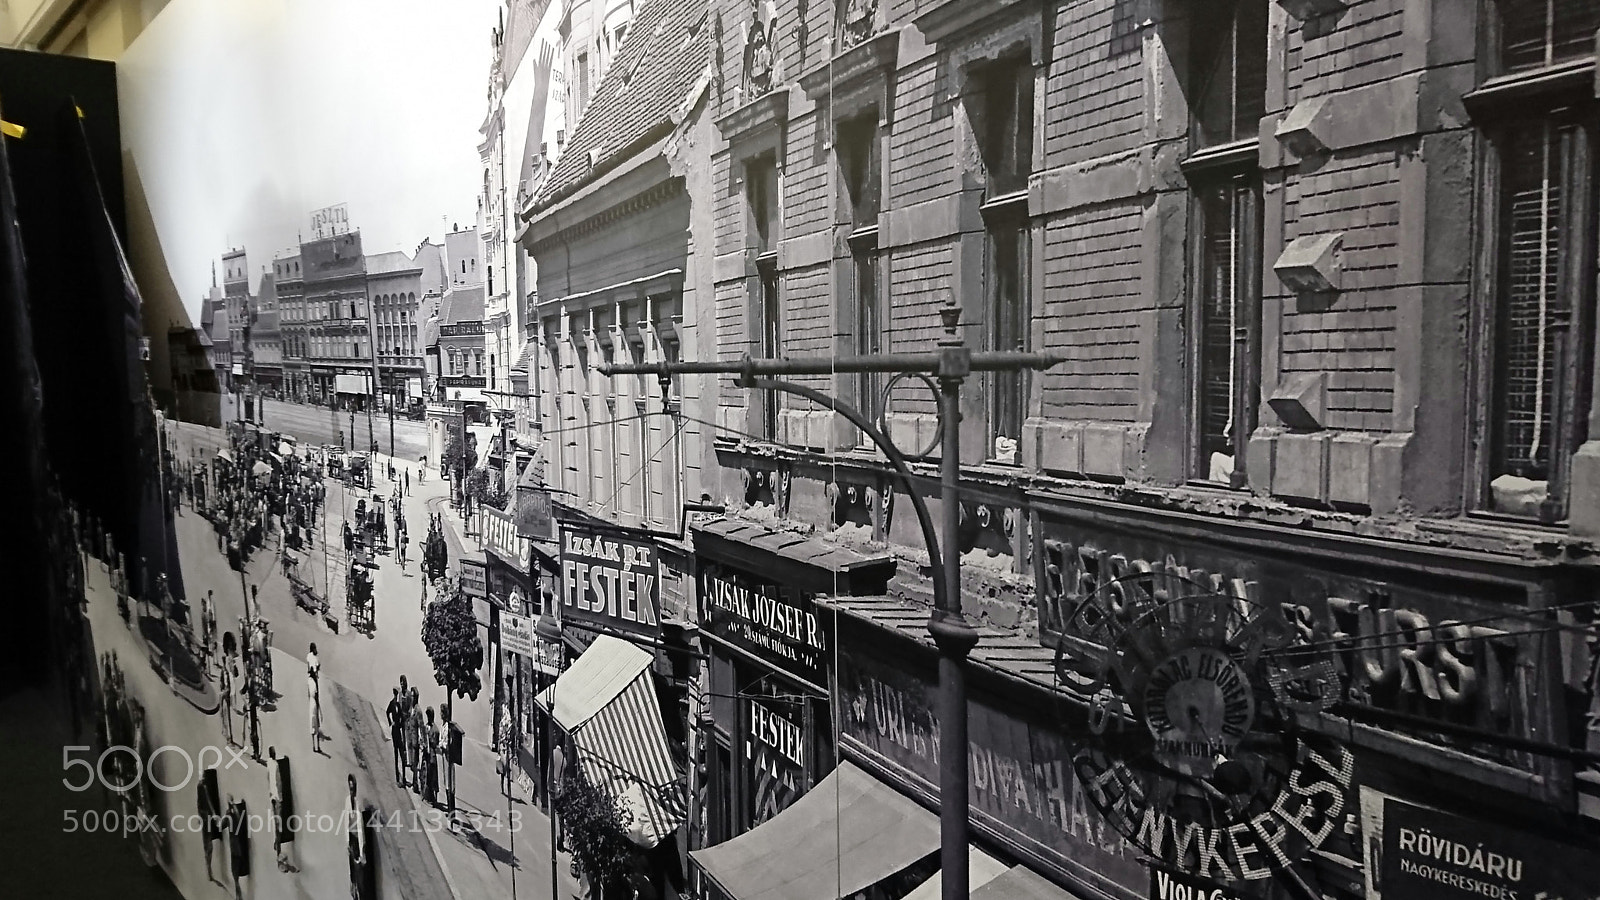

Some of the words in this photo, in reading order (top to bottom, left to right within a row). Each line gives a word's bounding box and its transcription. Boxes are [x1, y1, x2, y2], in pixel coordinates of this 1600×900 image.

[565, 531, 621, 562] IZSÁK
[562, 563, 658, 627] FESTÉK
[714, 574, 751, 620] IZSÁK
[752, 584, 804, 641] JÓZSEF
[751, 699, 804, 768] FESTÉK
[1399, 827, 1523, 882] RÖVIDÁRU
[1400, 858, 1519, 900] NAGYKERESKEDÉS
